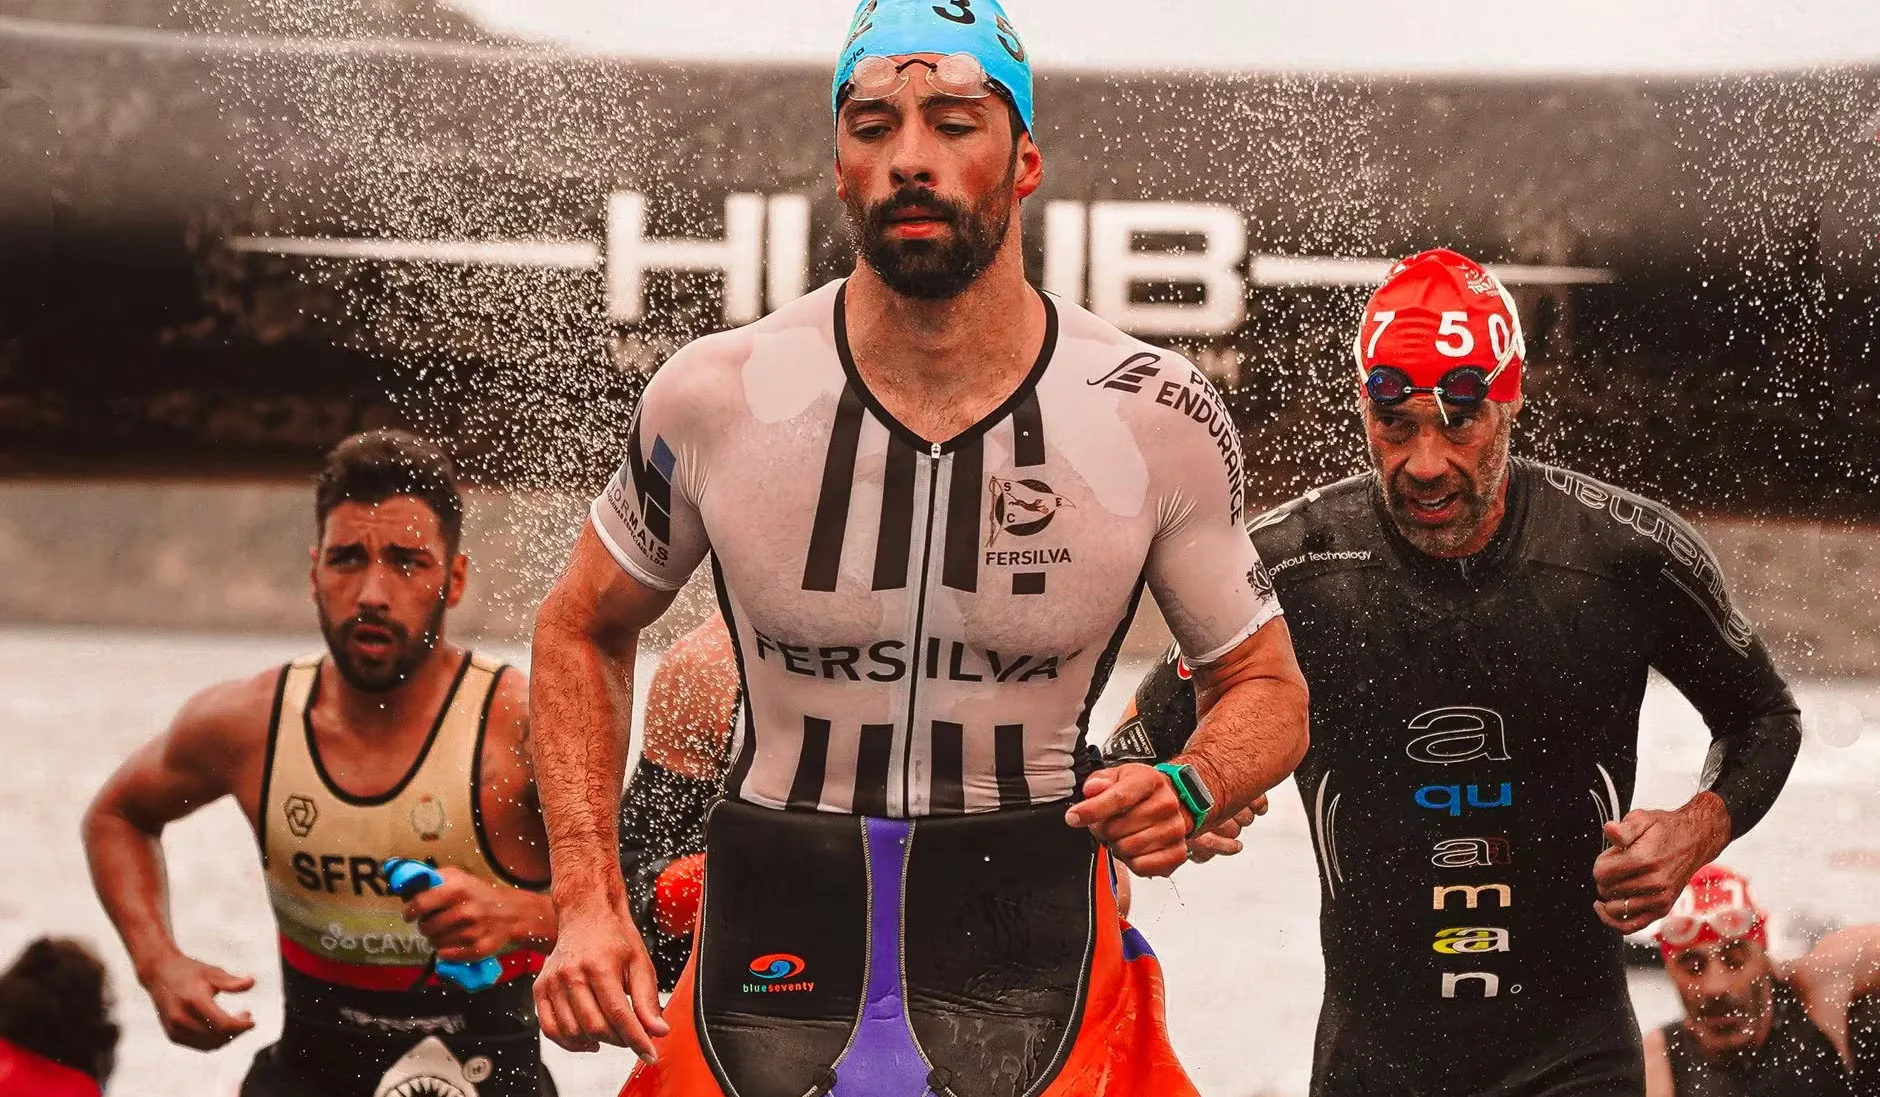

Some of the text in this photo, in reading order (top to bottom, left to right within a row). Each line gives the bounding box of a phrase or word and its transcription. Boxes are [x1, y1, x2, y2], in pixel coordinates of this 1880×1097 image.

[1155, 381, 1242, 526] ENDURANCE
[985, 547, 1072, 566] FERSILVA
[1268, 550, 1371, 577] ontour Technology
[742, 981, 815, 993] blueseventy
